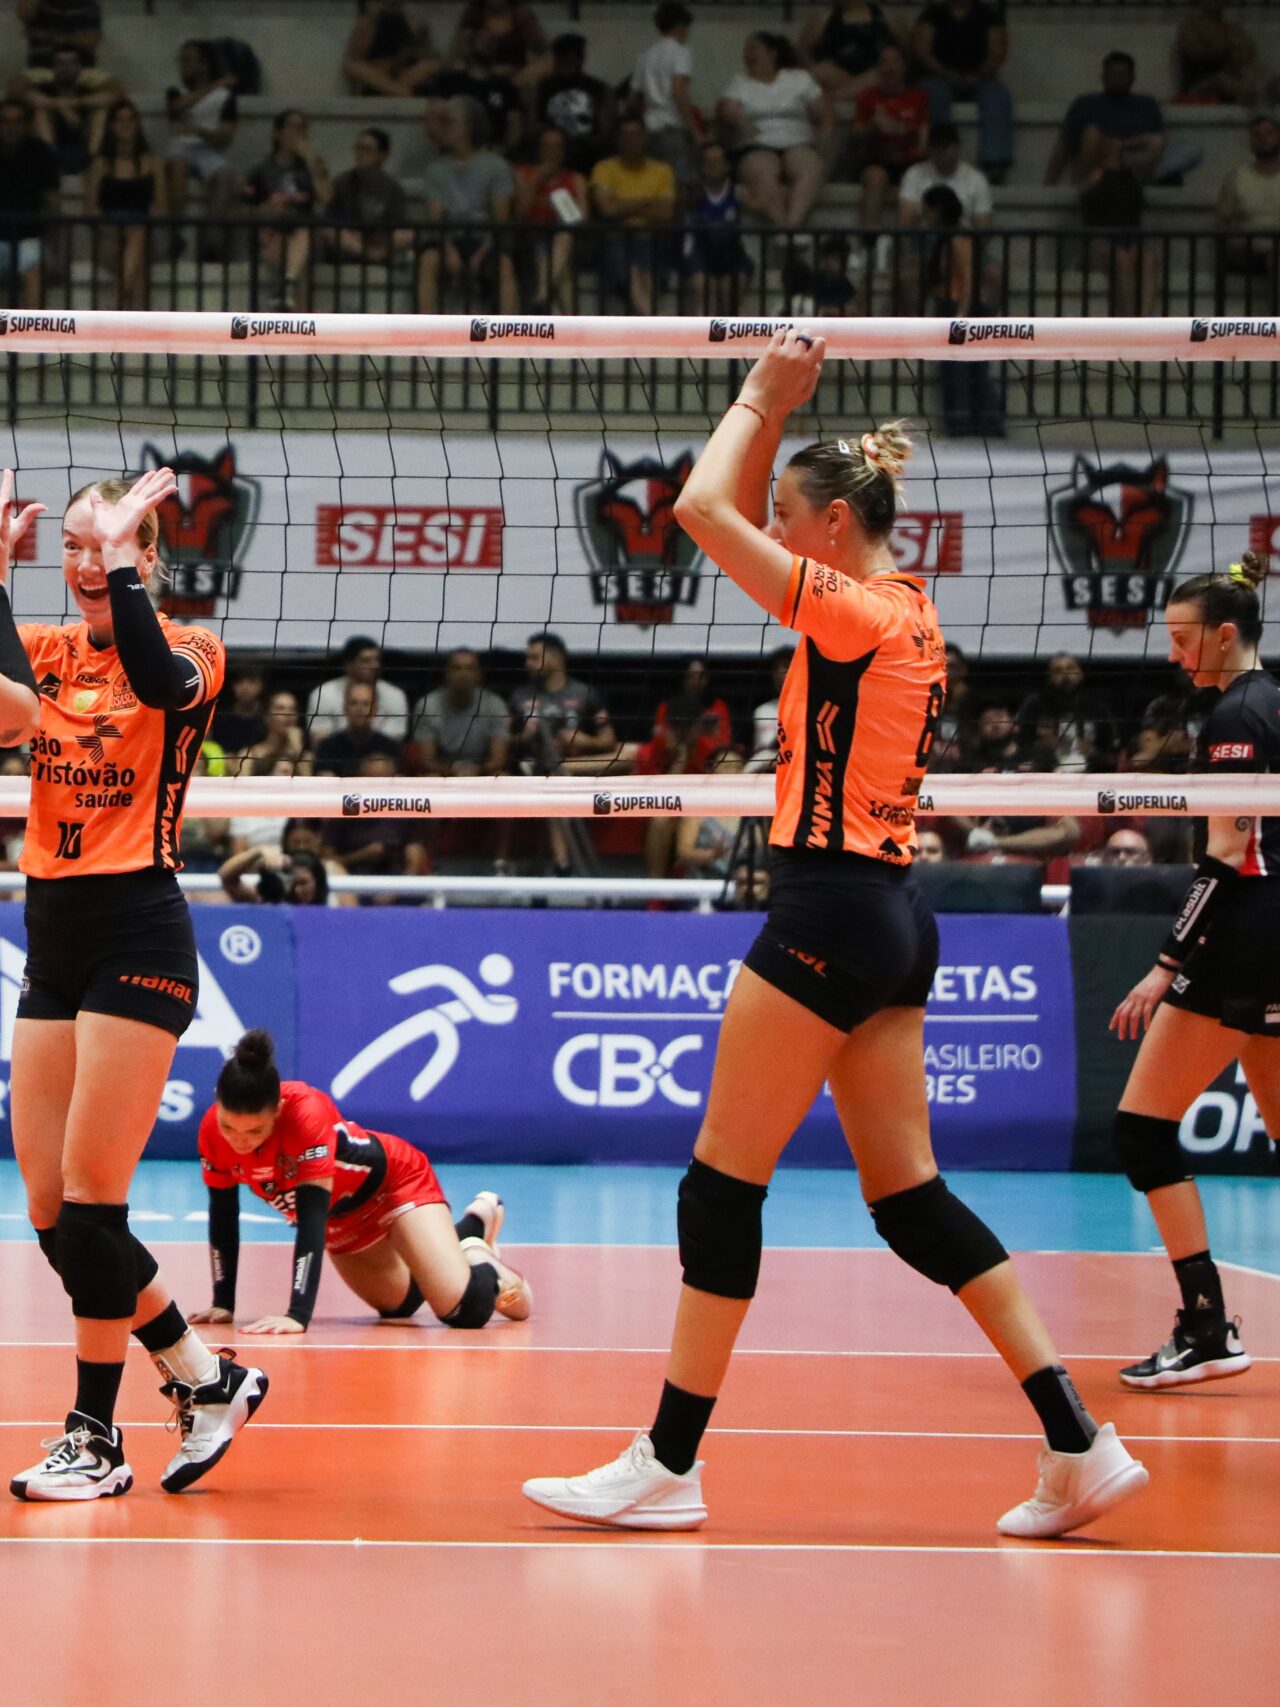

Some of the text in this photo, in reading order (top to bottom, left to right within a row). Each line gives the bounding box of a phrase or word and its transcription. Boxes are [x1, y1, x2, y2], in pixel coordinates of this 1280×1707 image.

[10, 315, 76, 335] SUPERLIGA
[250, 318, 317, 338] SUPERLIGA
[488, 322, 555, 340] SUPERLIGA
[728, 322, 794, 339] SUPERL
[968, 324, 1035, 342] SUPERLIGA
[1210, 321, 1277, 339] SUPERLIGA
[330, 511, 488, 566] SESI
[174, 563, 236, 597] ESI
[600, 574, 696, 602] SESI
[1072, 576, 1166, 607] SESI
[76, 790, 133, 808] saúde
[362, 798, 432, 814] SUPERLIGA
[614, 795, 682, 812] SUPERLIGA
[806, 760, 834, 849] YANM
[1118, 795, 1188, 812] SUPERLIGA
[160, 782, 183, 871] YANM
[55, 821, 84, 860] 10
[549, 958, 743, 1010] FORMAÇ
[927, 965, 1038, 1002] ETAS
[923, 1044, 1042, 1071] ASILEIRO
